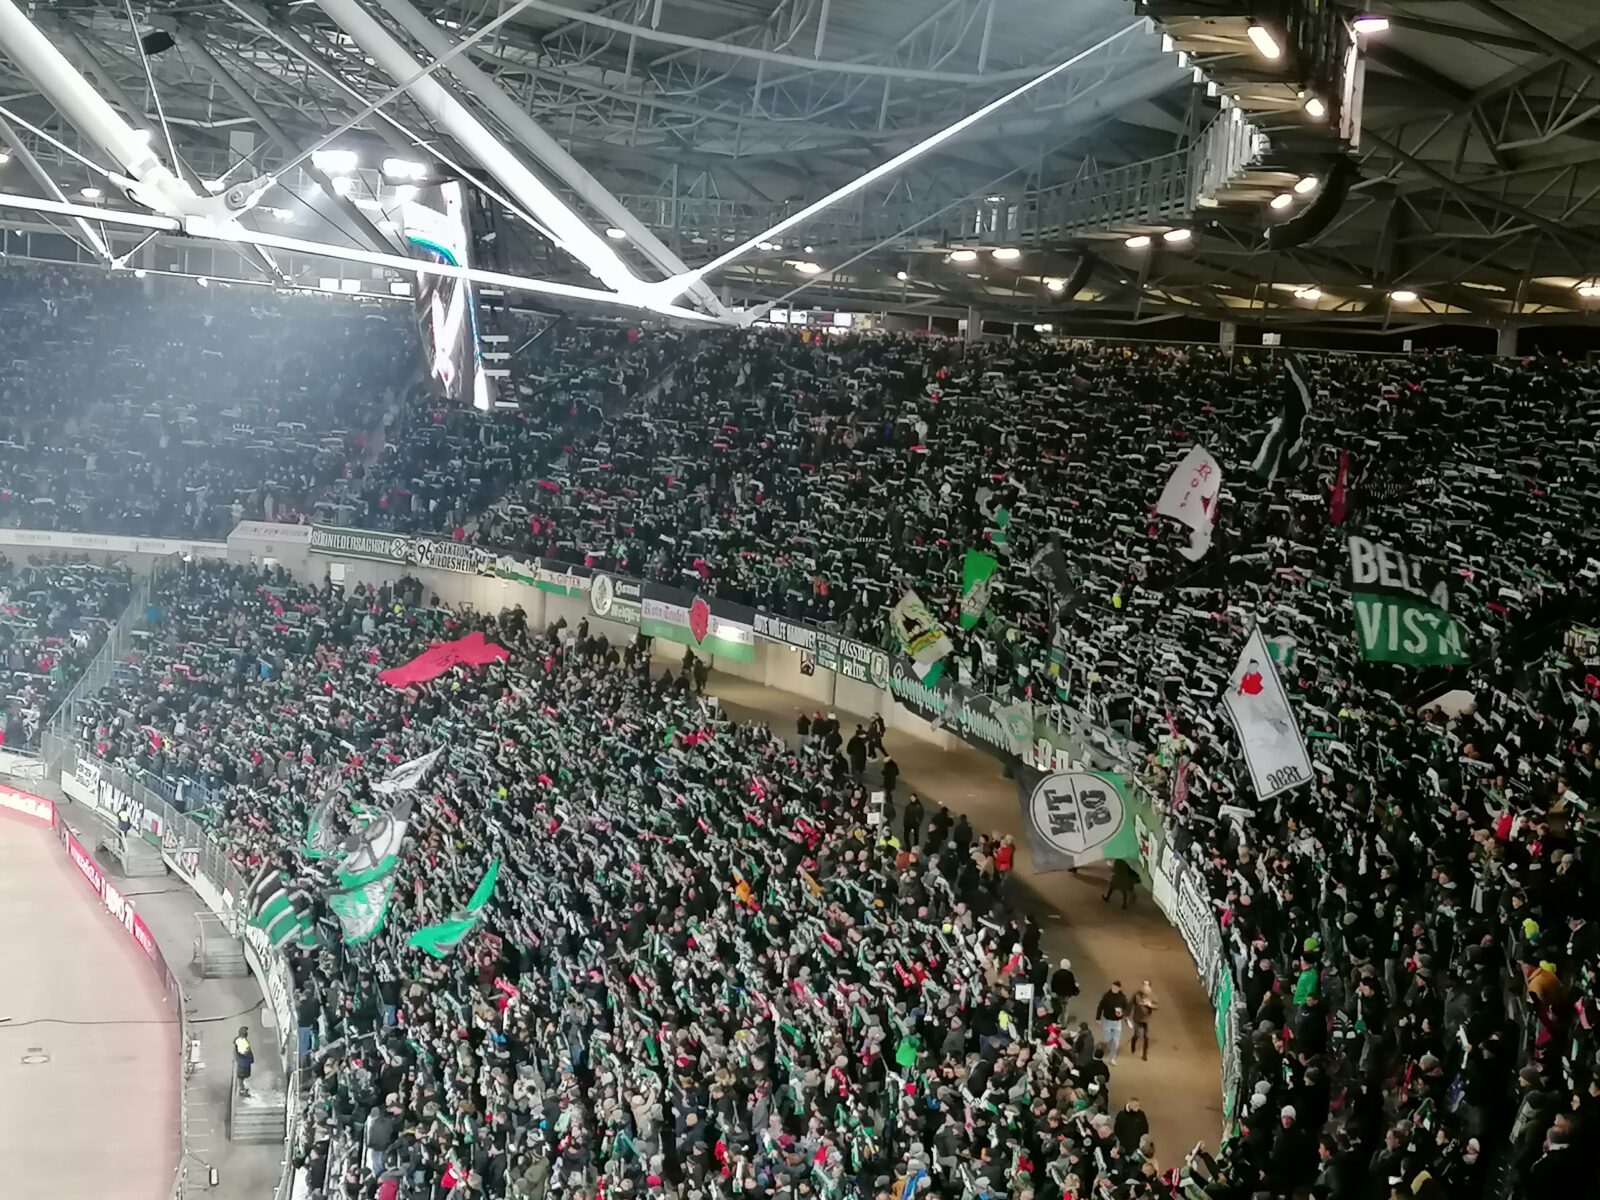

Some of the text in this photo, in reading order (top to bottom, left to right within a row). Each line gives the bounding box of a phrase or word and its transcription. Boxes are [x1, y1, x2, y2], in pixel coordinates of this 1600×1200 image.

[438, 542, 470, 558] SEKTION
[430, 554, 478, 573] HILDESHEIM
[840, 638, 873, 664] PASSION
